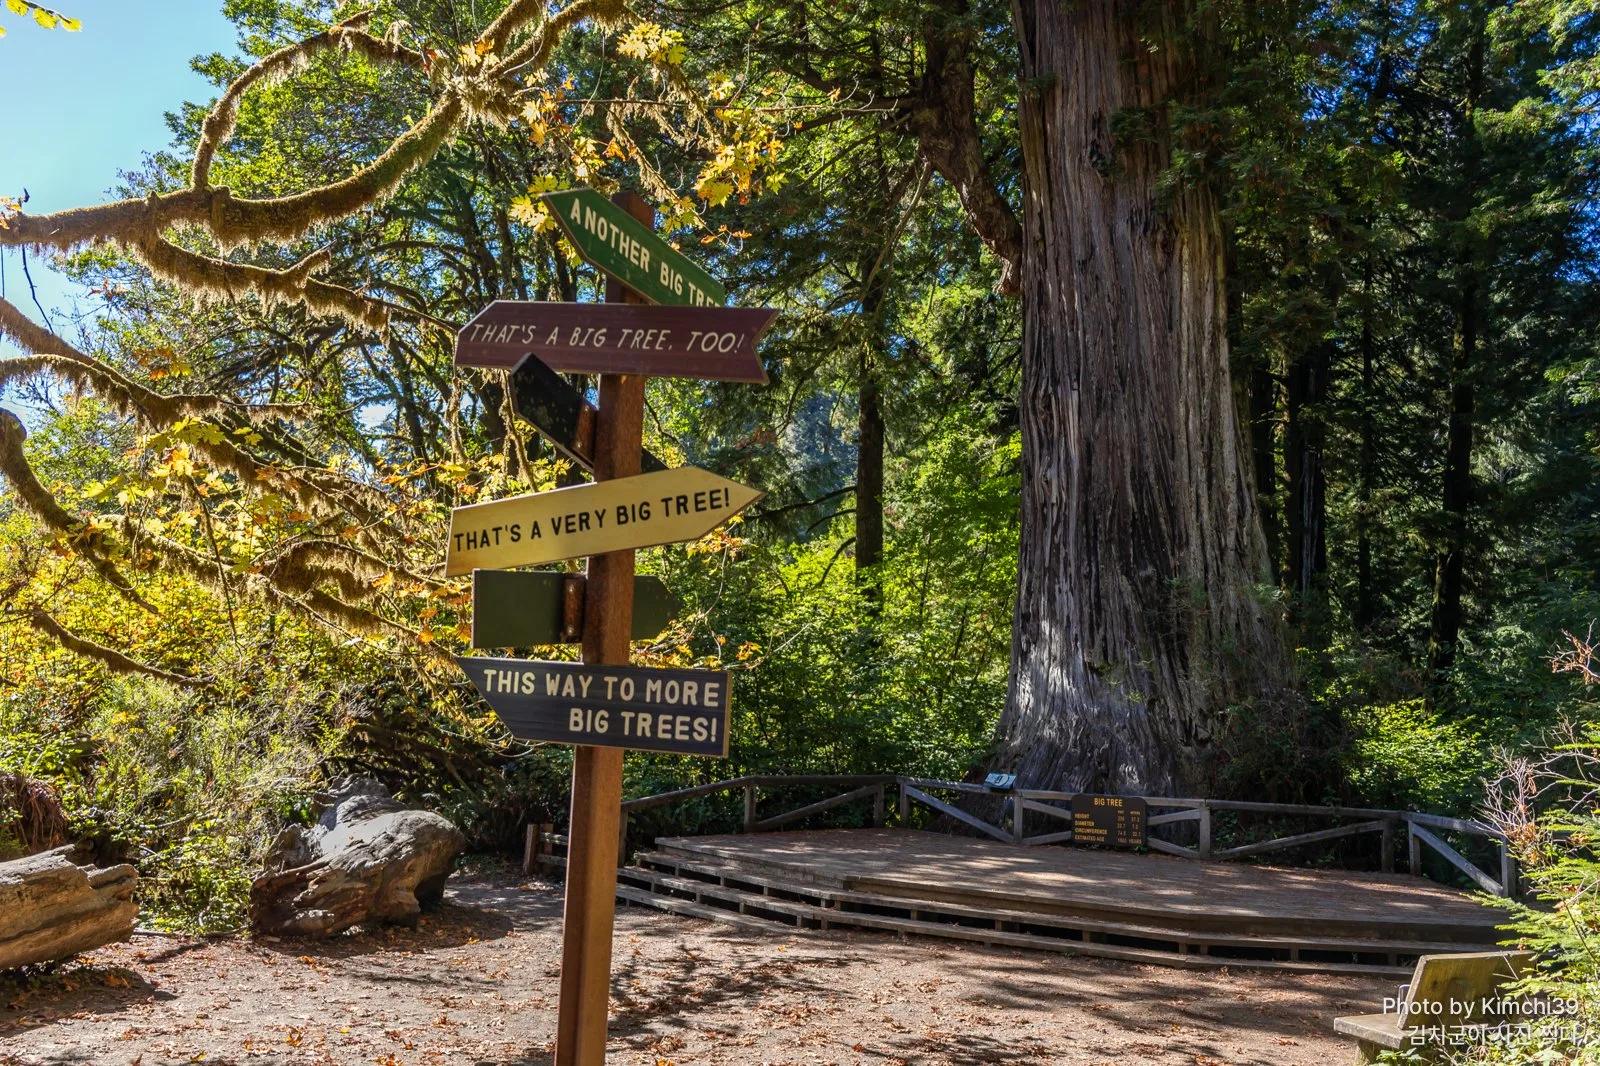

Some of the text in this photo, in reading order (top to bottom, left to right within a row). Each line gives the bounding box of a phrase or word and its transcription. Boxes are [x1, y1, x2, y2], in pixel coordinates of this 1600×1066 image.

[570, 197, 721, 307] ANOTHER BIG TRE
[469, 323, 537, 344] THAT'S
[546, 327, 558, 345] A
[569, 327, 606, 347] BIG
[686, 331, 745, 354] TOO!
[454, 487, 730, 552] THAT'S A VERY BIG TREE!
[483, 669, 720, 707] THIS WAY TO MORE
[568, 708, 718, 742] BIG TREES!
[1094, 797, 1123, 807] BIG TREE
